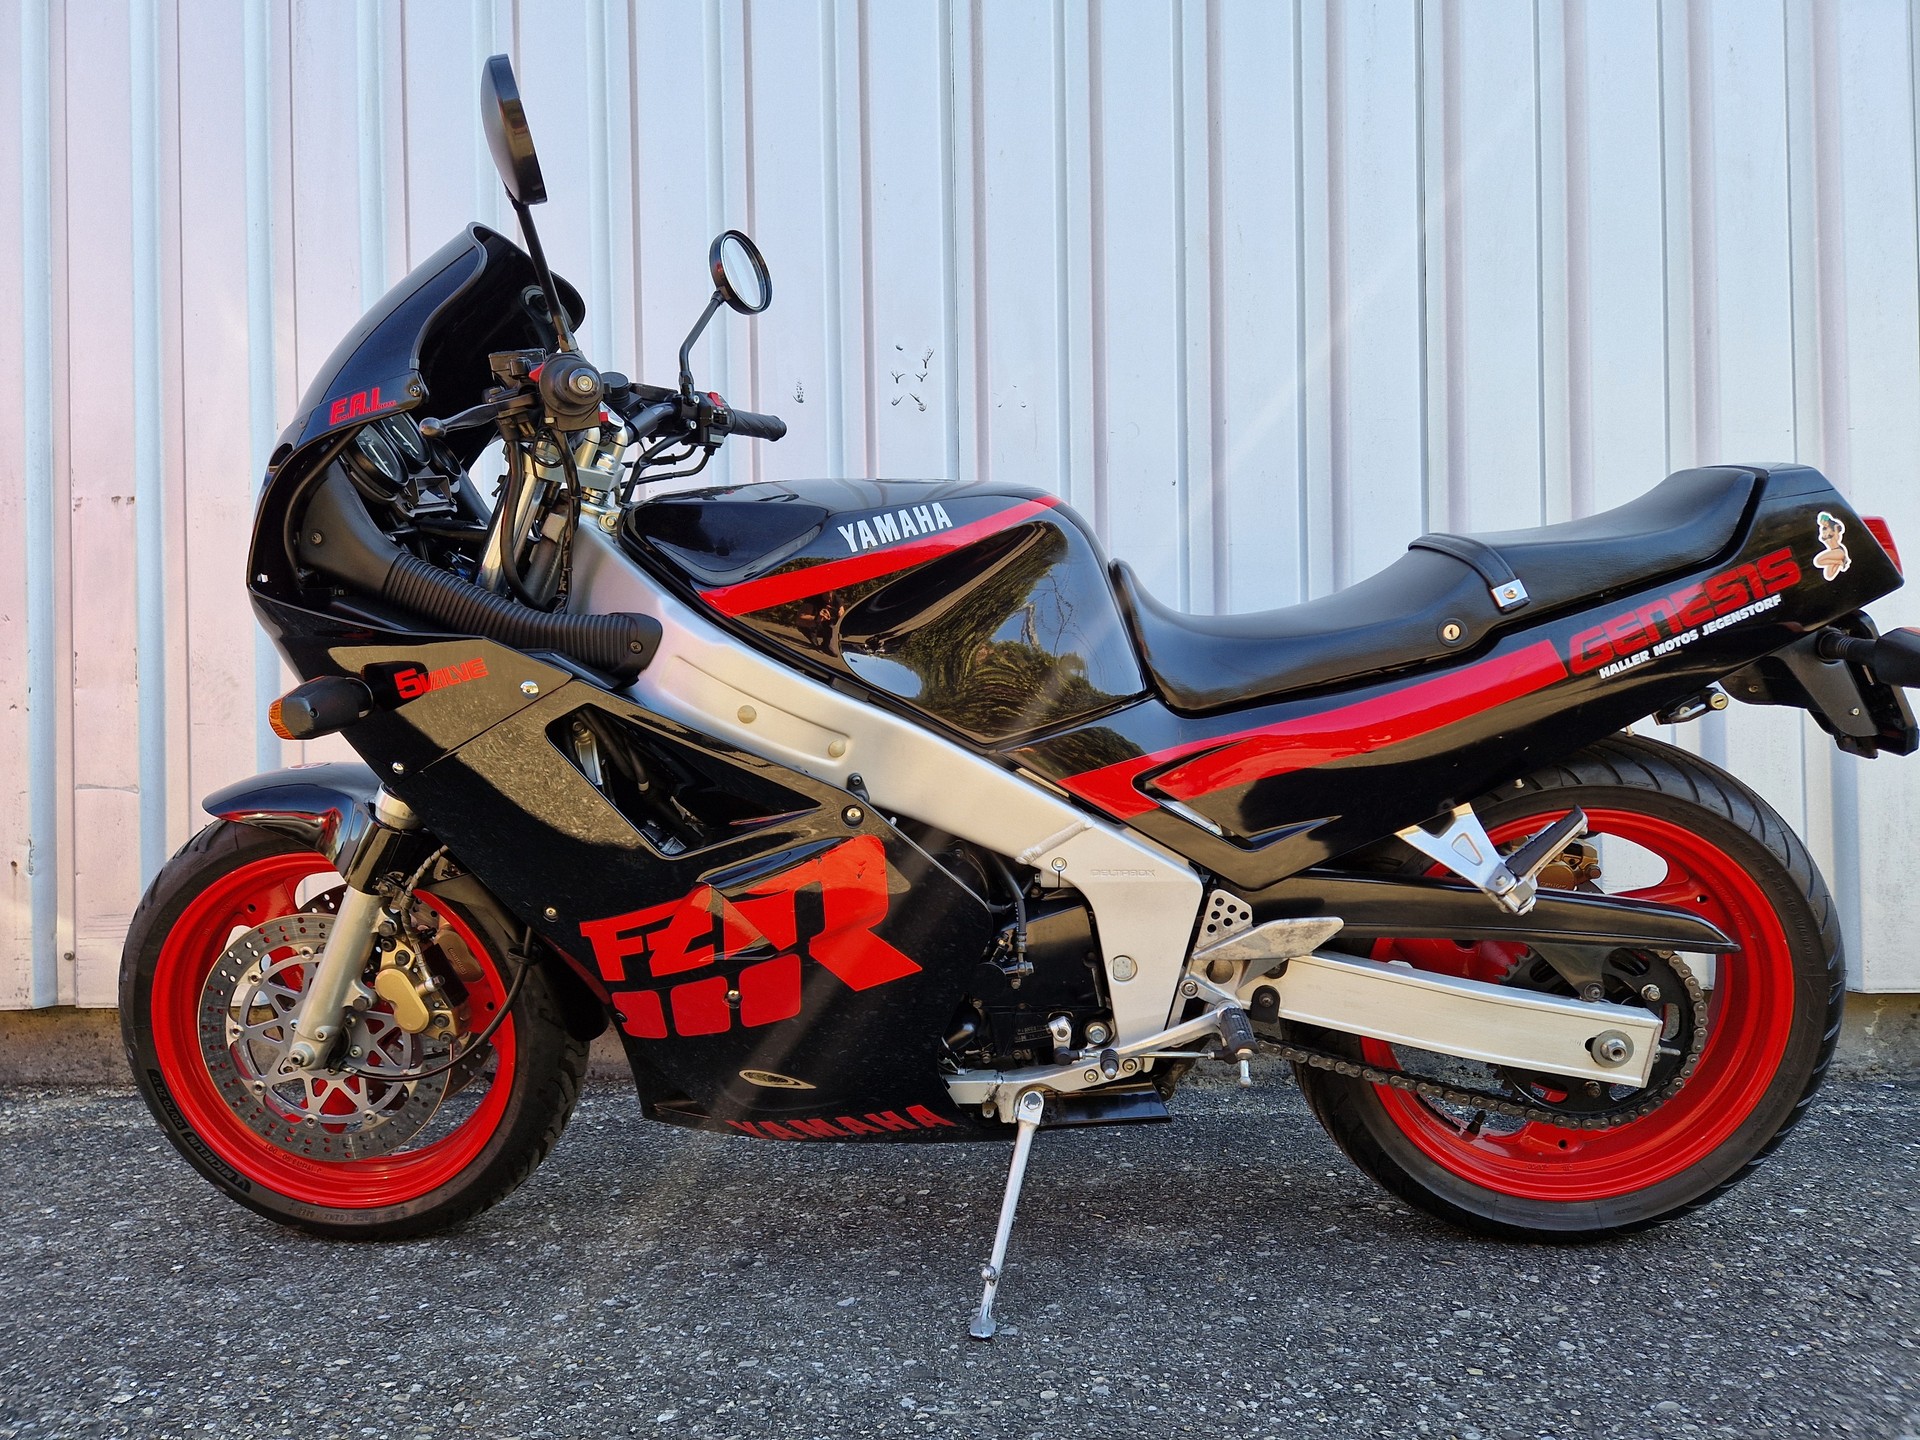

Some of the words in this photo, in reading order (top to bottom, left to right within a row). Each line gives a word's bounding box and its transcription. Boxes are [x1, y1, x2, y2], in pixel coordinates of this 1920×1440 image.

[837, 502, 953, 553] YAMAHA
[1567, 547, 1802, 675] GENESIS
[1599, 650, 1650, 680] HALLER
[1652, 628, 1699, 657] MOTOS
[1702, 593, 1782, 637] JEGENSTORF
[579, 834, 923, 992] FZR
[186, 1134, 237, 1179] MICHELIN
[724, 1104, 957, 1140] YAMAHA
